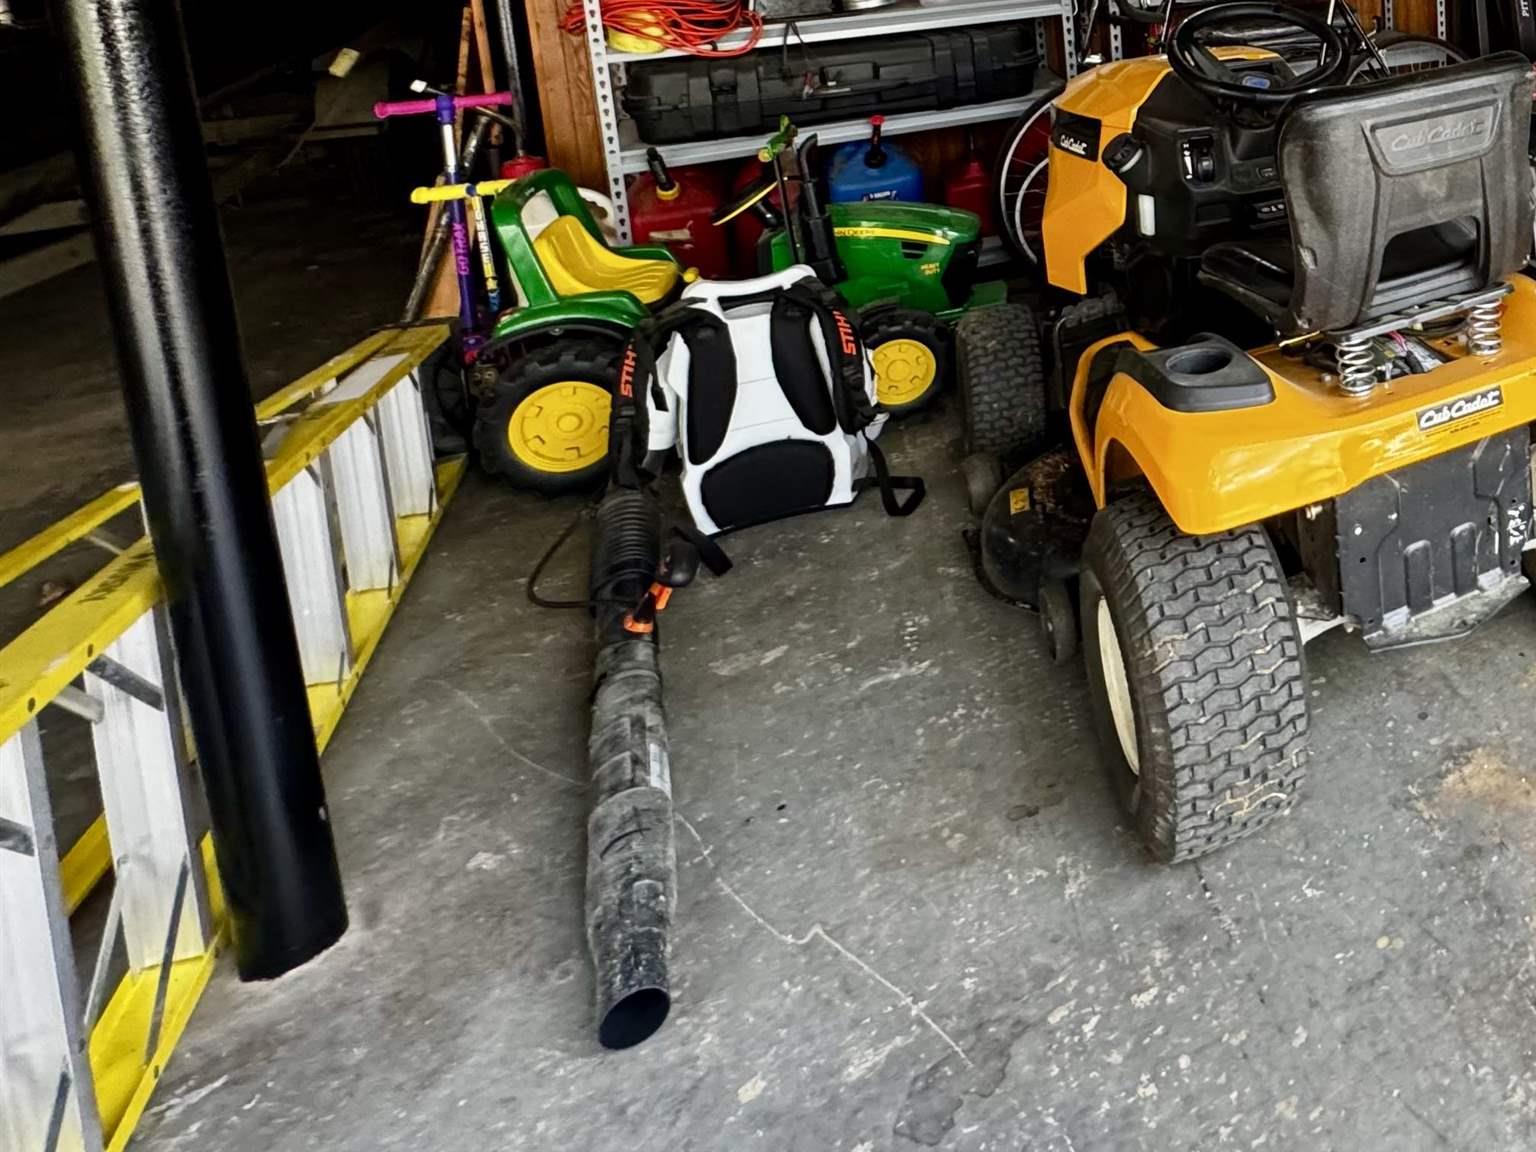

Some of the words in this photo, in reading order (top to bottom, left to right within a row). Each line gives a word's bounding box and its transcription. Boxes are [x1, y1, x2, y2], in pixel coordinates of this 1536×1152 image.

[621, 345, 637, 397] STIH
[1420, 405, 1451, 429] Cub
[1450, 389, 1500, 418] Cadet
